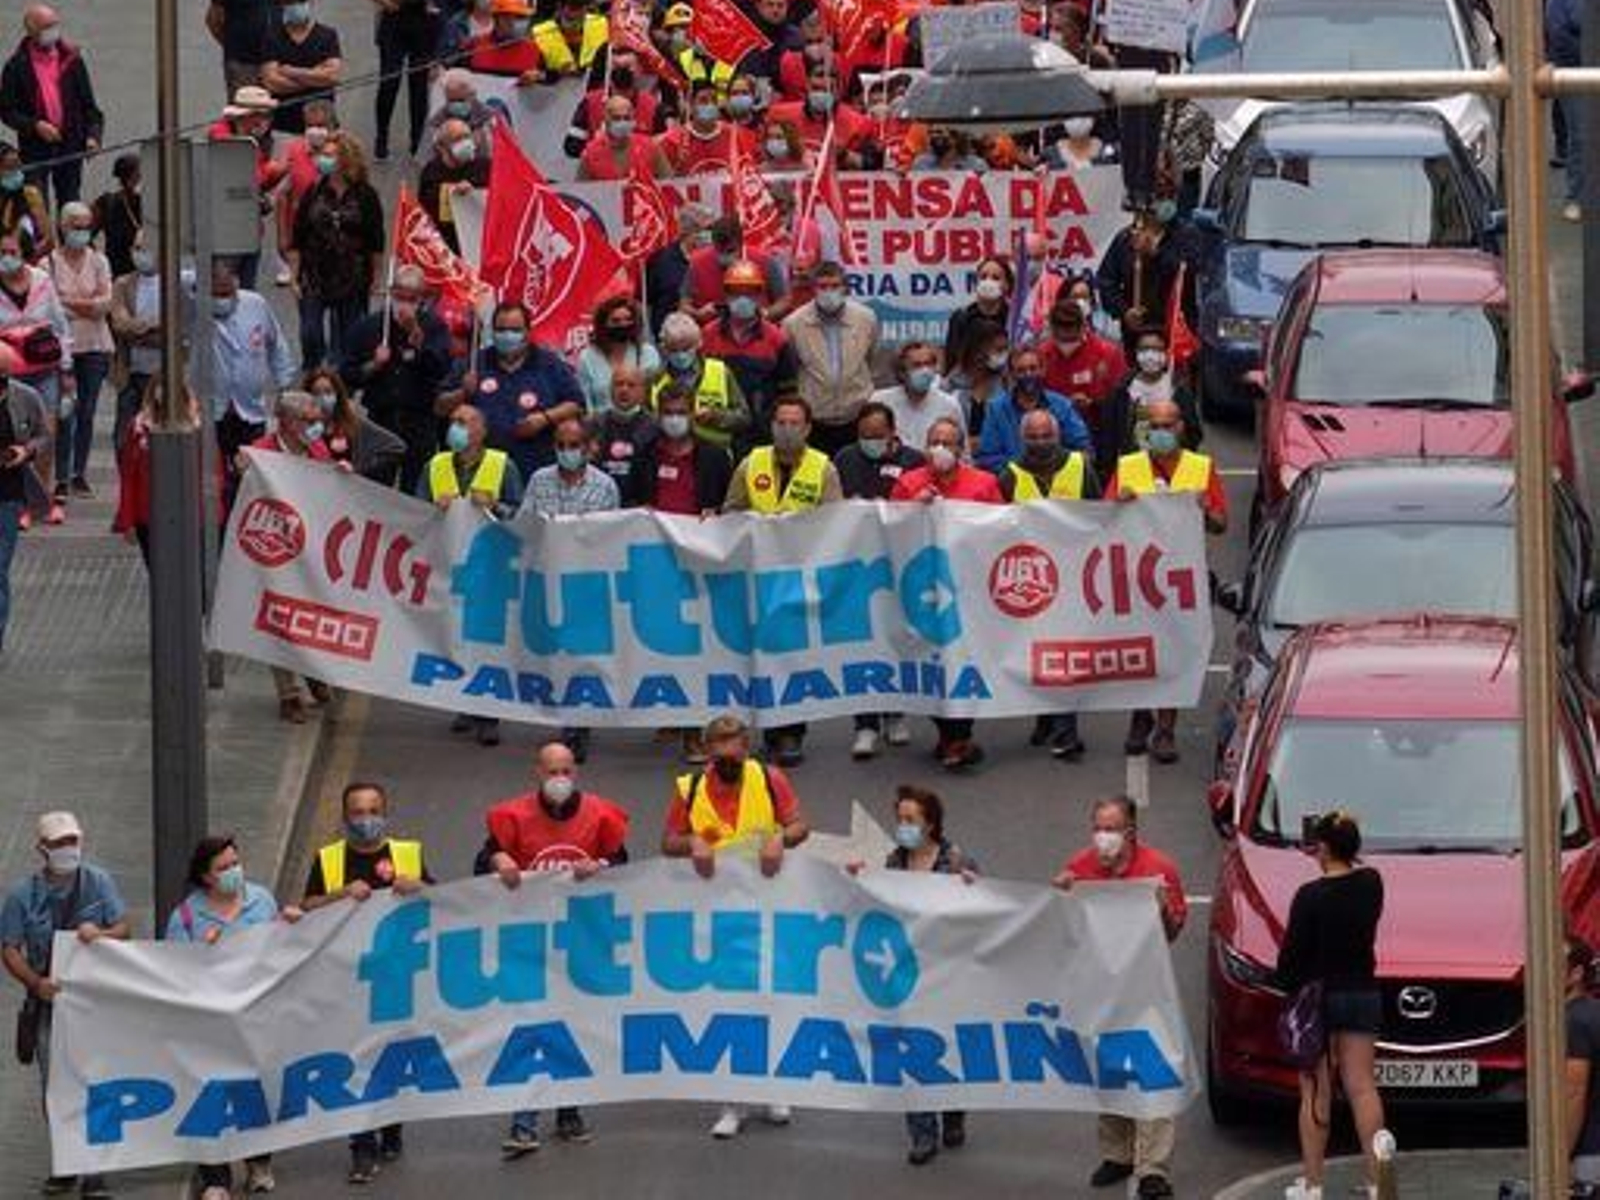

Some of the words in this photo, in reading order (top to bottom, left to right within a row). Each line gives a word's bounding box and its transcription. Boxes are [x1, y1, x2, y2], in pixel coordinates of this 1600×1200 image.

[911, 272, 953, 296] DA
[324, 516, 432, 606] CIG
[451, 521, 962, 657] futuro
[998, 554, 1050, 590] UGT
[1081, 543, 1197, 616] CIG
[266, 603, 368, 650] CCOO
[411, 652, 614, 709] PARA
[629, 673, 692, 709] A
[1041, 646, 1148, 678] CCOO
[356, 892, 920, 1023] futuro
[86, 1036, 460, 1146] PARA
[487, 1019, 594, 1085] A
[622, 1002, 1183, 1091] MARIÑA
[1432, 1064, 1472, 1083] KKP
